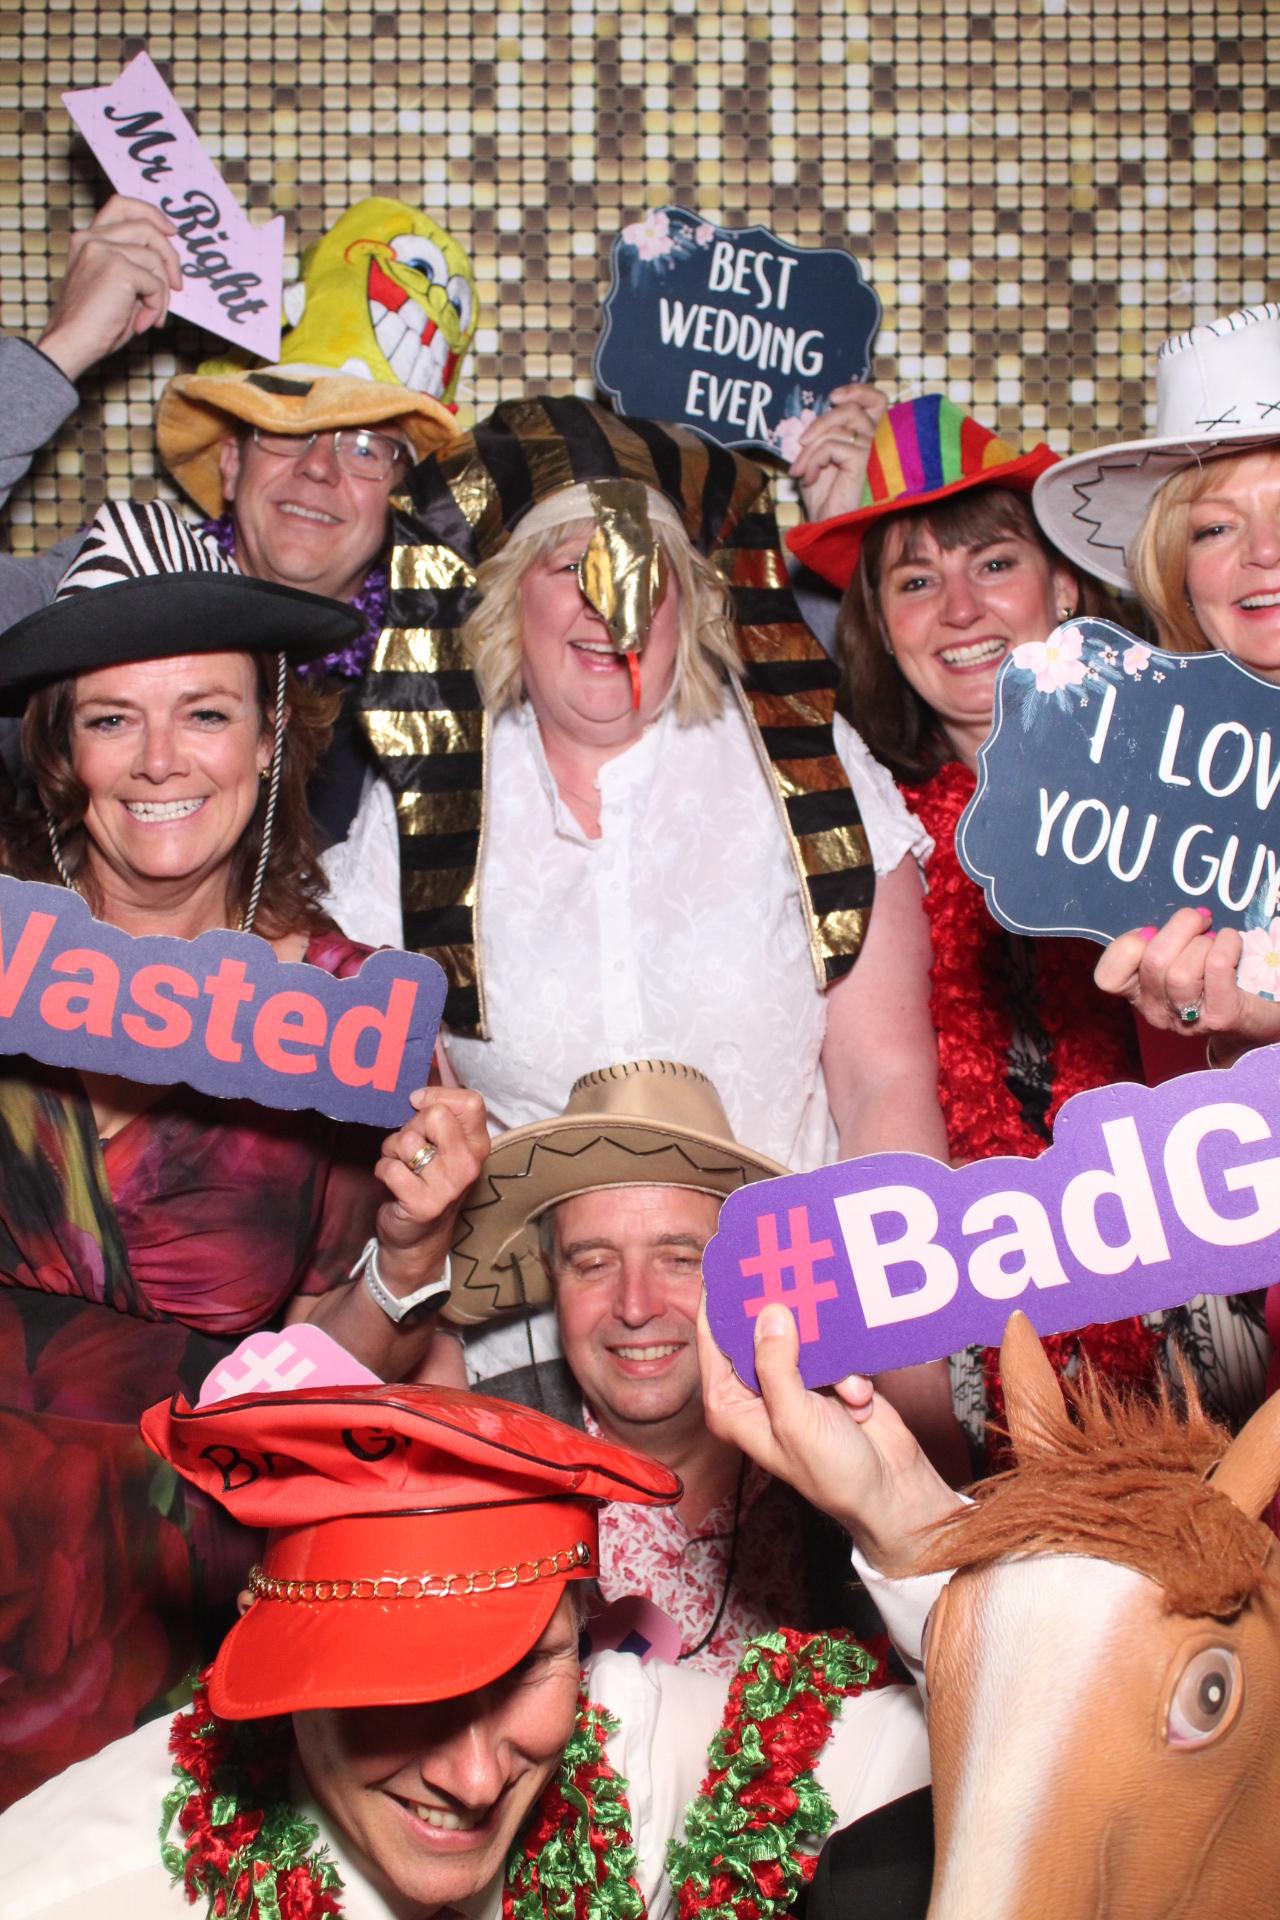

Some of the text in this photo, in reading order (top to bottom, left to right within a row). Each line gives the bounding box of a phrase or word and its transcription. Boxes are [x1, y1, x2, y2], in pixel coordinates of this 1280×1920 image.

[103, 105, 269, 324] Mr Right
[708, 242, 798, 311] BEST
[660, 298, 824, 376] WEDDING
[685, 369, 773, 440] EVER
[1089, 684, 1117, 764] I
[1035, 788, 1158, 882] YOU
